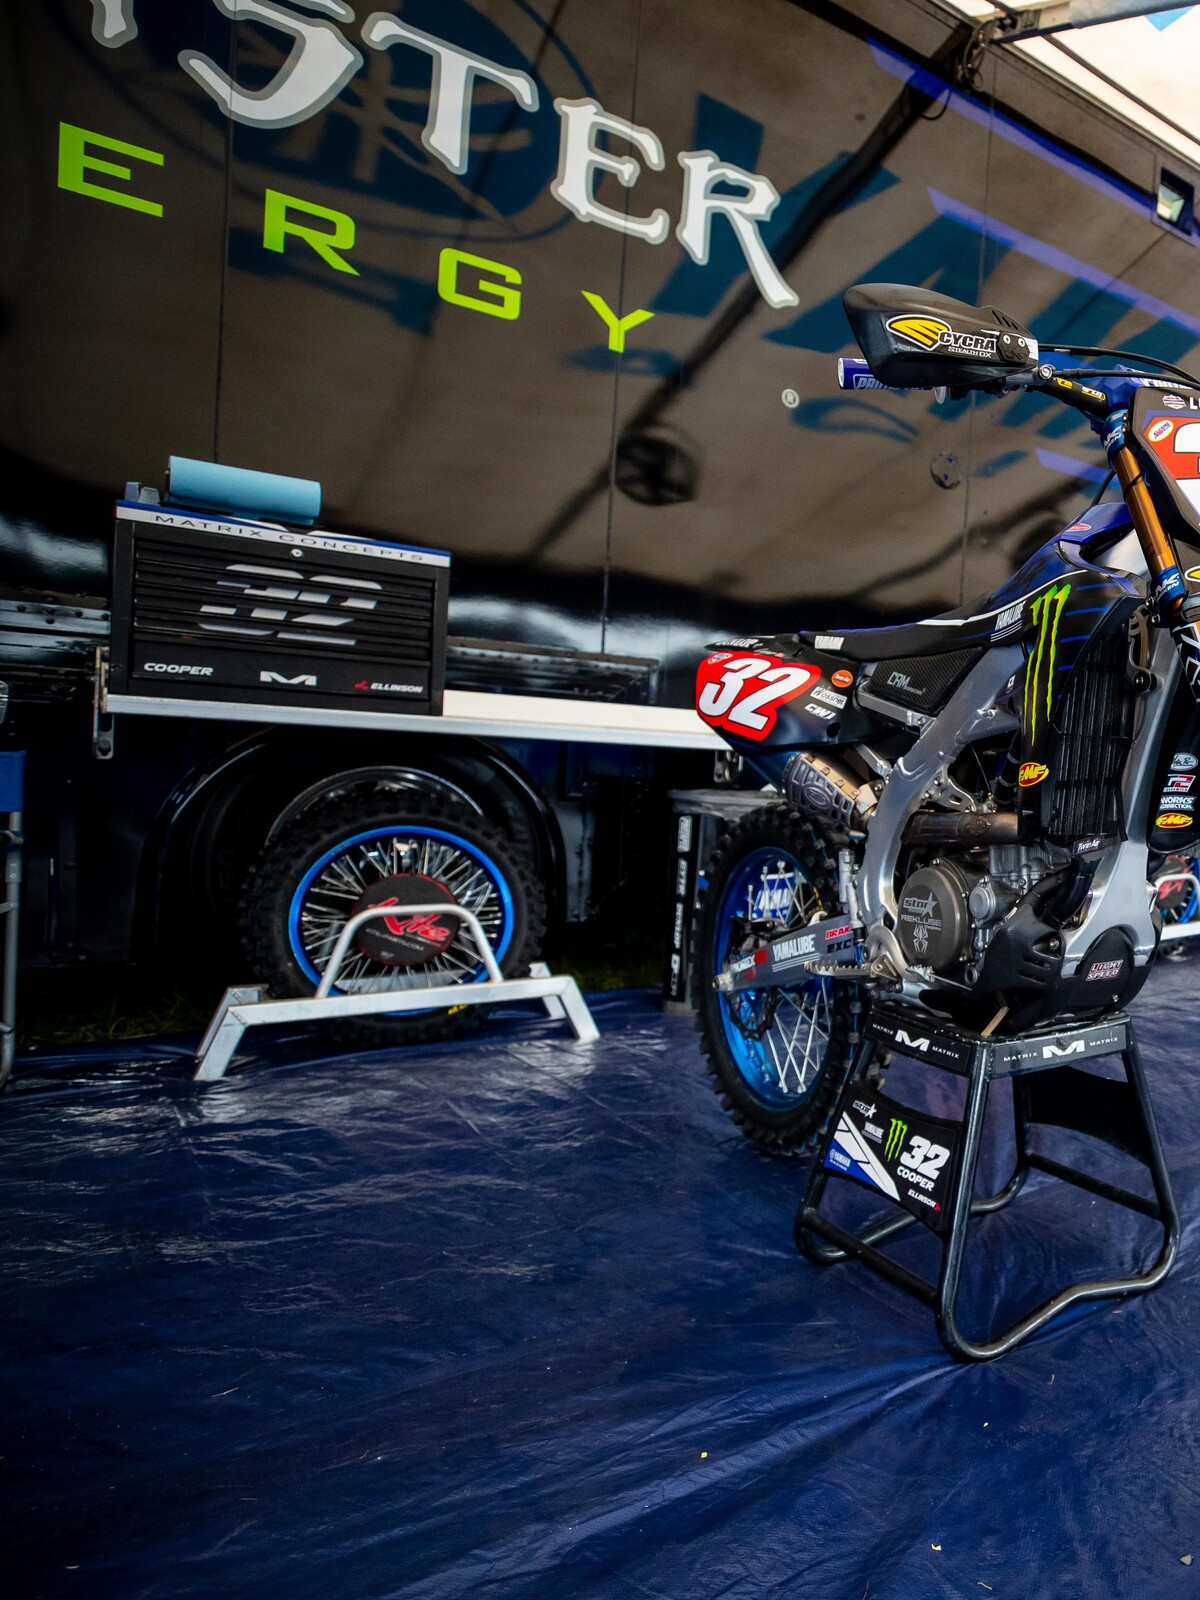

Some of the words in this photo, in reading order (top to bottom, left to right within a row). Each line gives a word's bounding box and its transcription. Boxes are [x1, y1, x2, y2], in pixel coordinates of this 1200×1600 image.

[91, 0, 800, 308] STER
[937, 331, 997, 352] CYCRA
[155, 514, 262, 538] MATRIX
[278, 533, 424, 562] CONCEPTS
[143, 662, 214, 676] COOPER
[369, 681, 424, 693] ELLINSON
[698, 656, 812, 731] 32
[1160, 796, 1193, 806] WORKS
[825, 926, 852, 939] BRAK
[901, 914, 941, 927] REKLUSE
[772, 933, 817, 962] YAMALUBE
[826, 940, 853, 954] EXC
[872, 1022, 894, 1036] MATRIX
[931, 1045, 960, 1059] MATRIX
[1003, 1051, 1038, 1062] MATRIX
[1089, 1037, 1119, 1047] MATRIX
[899, 1134, 951, 1181] 32
[896, 1165, 935, 1192] COOPER
[907, 1188, 937, 1208] ELLINSON
